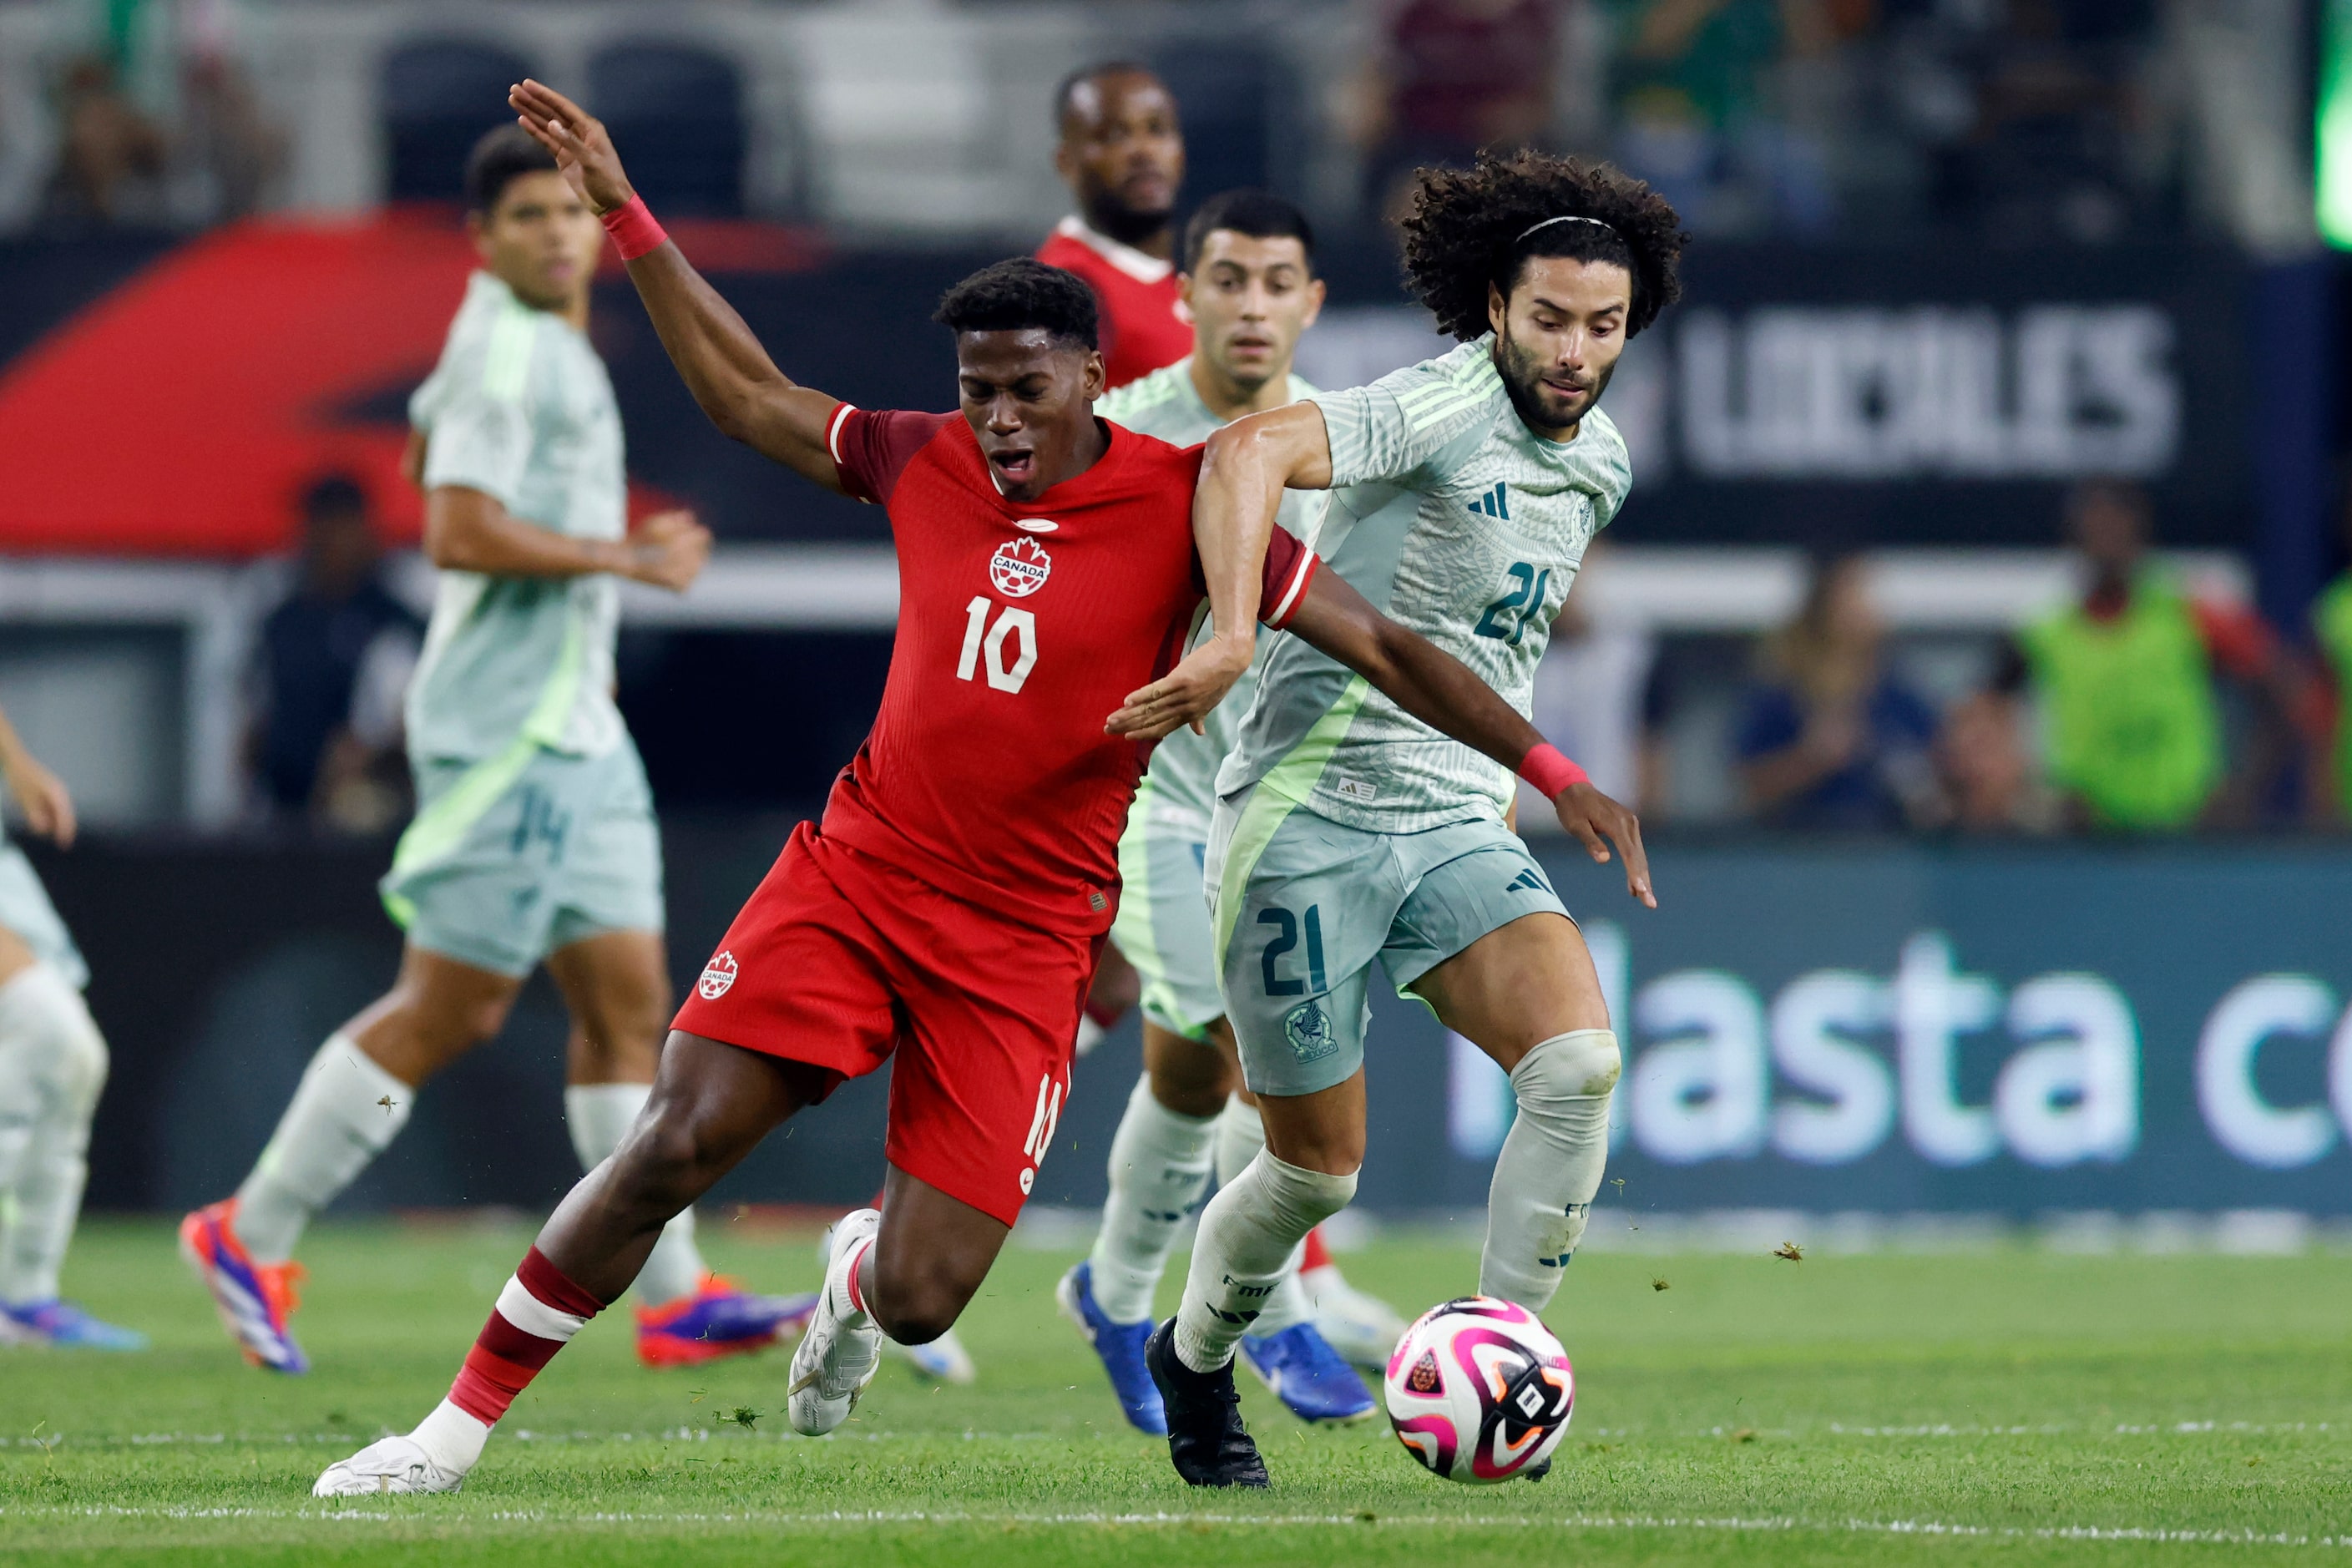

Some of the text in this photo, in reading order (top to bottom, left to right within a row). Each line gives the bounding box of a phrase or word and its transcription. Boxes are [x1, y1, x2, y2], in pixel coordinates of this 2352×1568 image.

[994, 557, 1044, 579] CANADA
[1473, 561, 1550, 646] 21
[956, 595, 1038, 695] 10
[511, 783, 574, 866] 14
[703, 971, 732, 982] CANADA
[1257, 903, 1328, 996] 21
[2194, 971, 2352, 1169] c
[1023, 1073, 1062, 1168] 10
